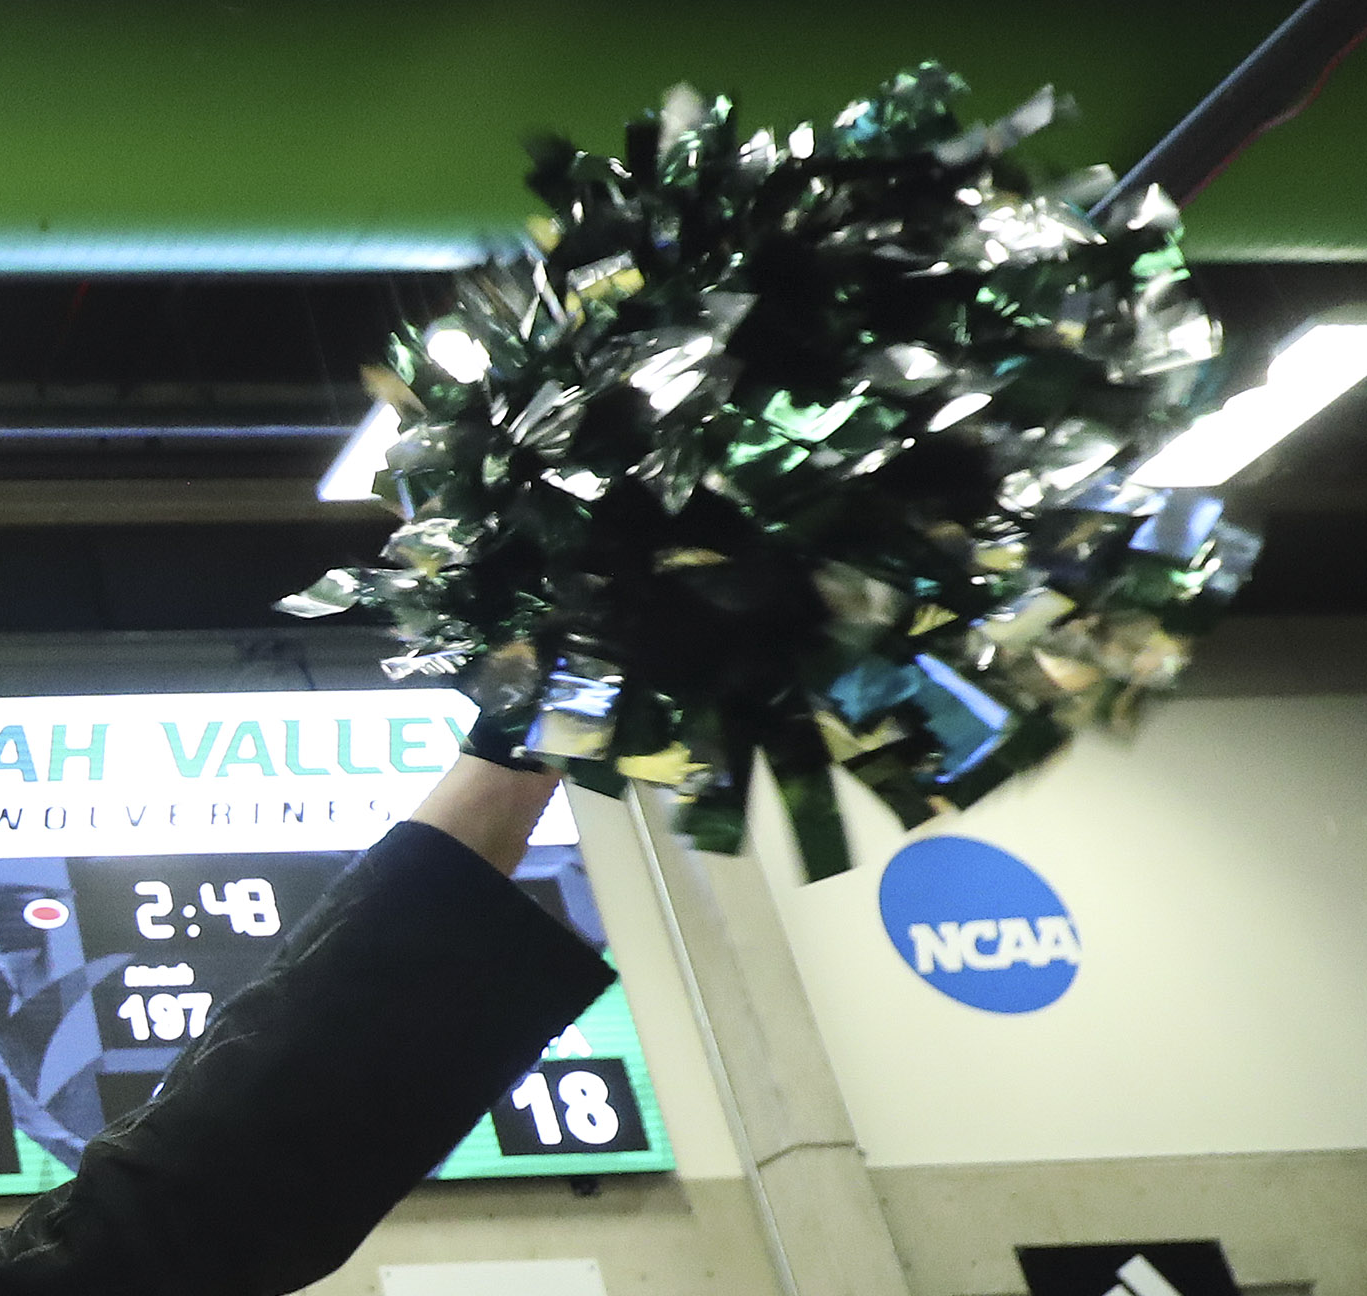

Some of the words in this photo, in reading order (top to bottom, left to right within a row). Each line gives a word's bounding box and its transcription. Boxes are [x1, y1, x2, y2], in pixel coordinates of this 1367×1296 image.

[134, 877, 281, 940] 2:48
[908, 915, 1080, 975] NCAA
[117, 992, 212, 1040] 197
[512, 1070, 619, 1145] 18
